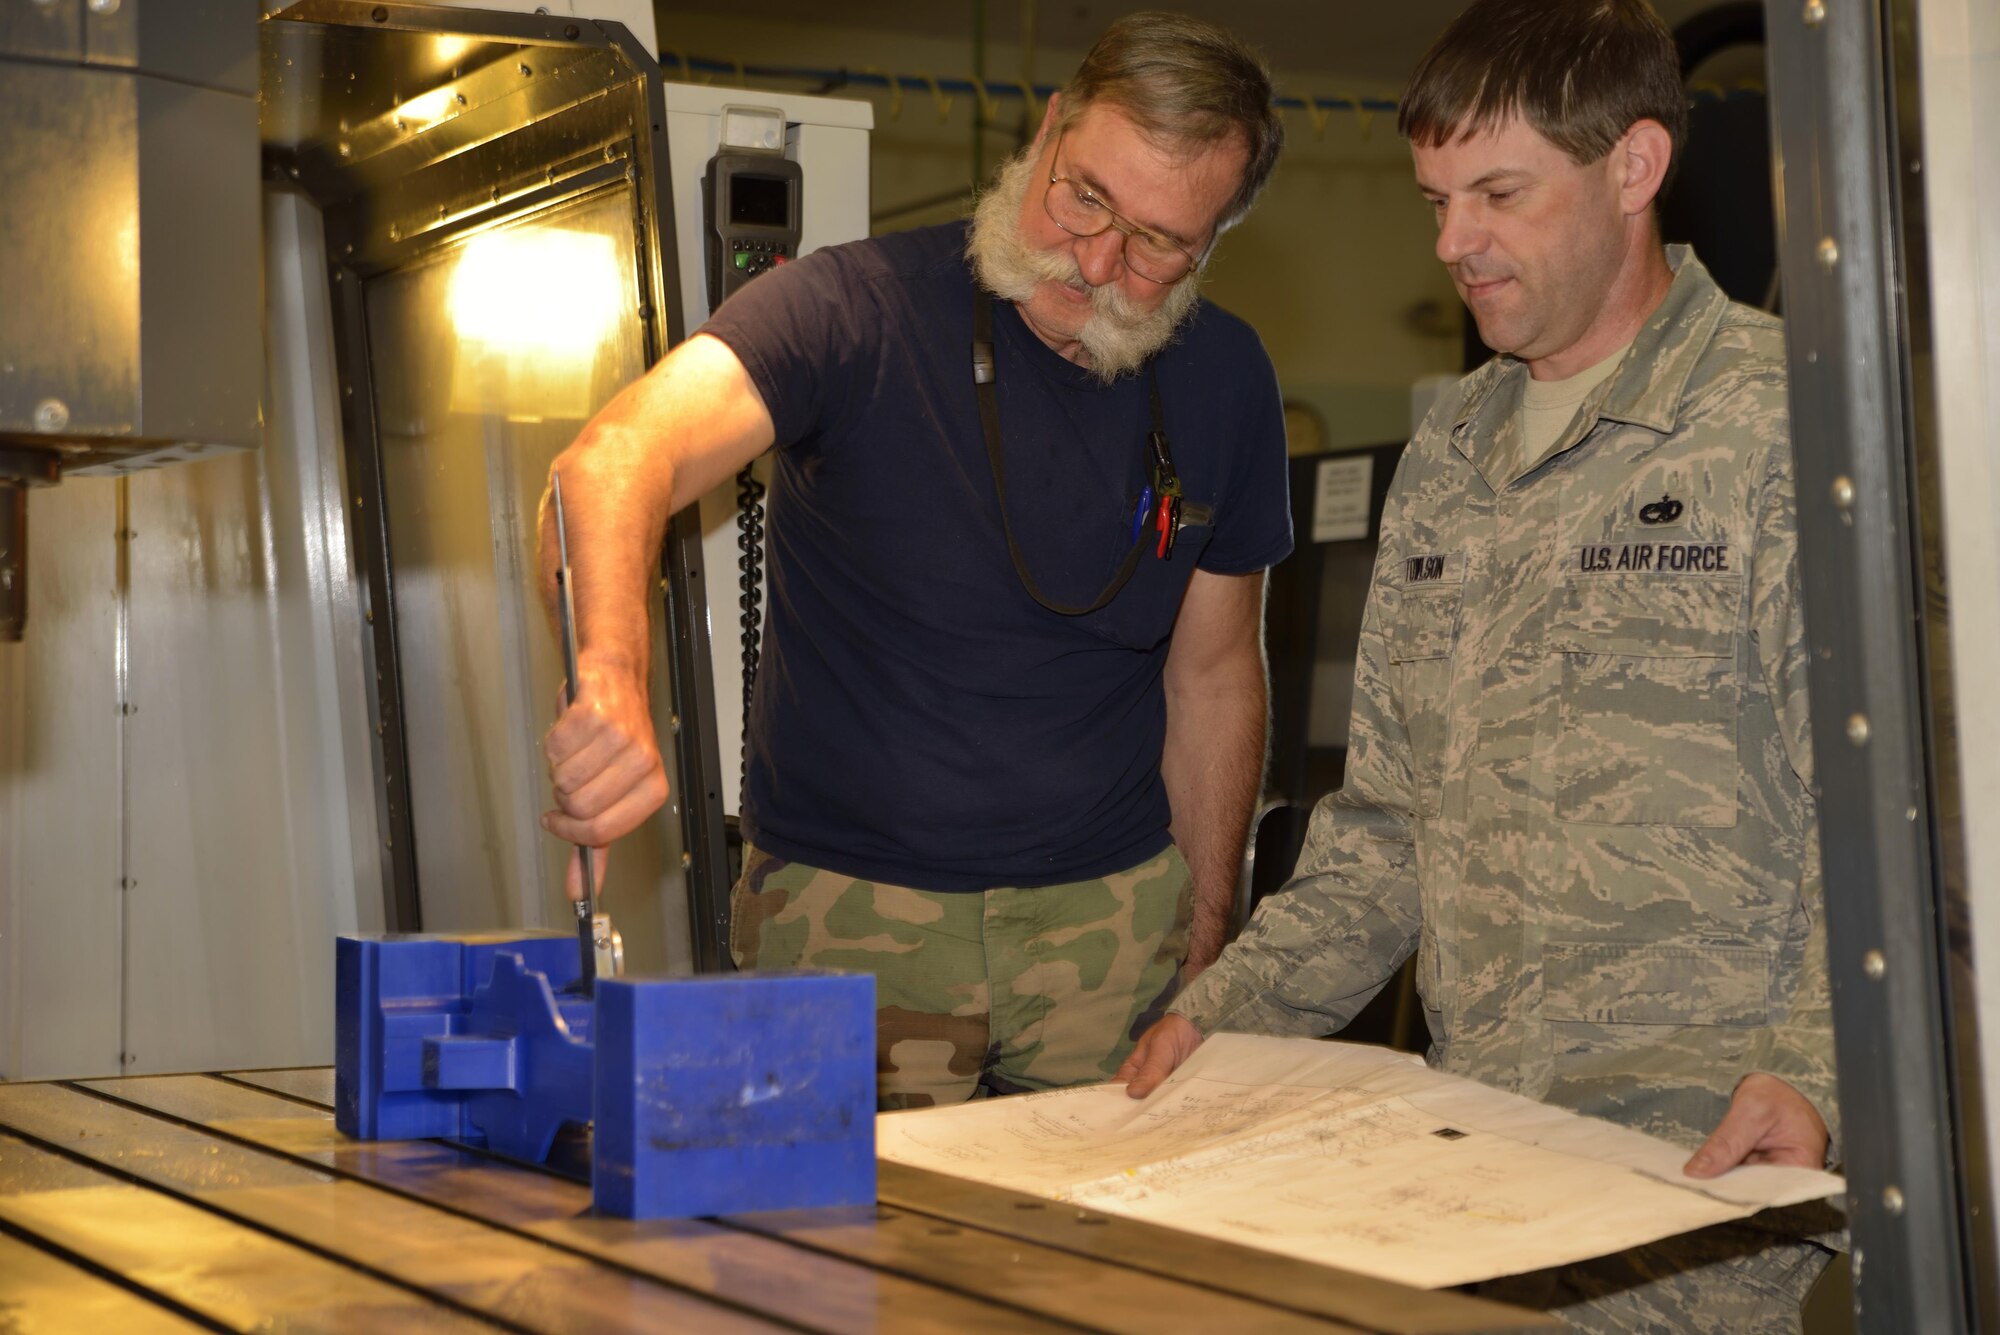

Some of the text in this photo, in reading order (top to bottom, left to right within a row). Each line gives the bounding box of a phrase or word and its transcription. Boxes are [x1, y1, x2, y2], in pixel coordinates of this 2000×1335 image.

[1581, 545, 1729, 572] U.S. AIR FORCE
